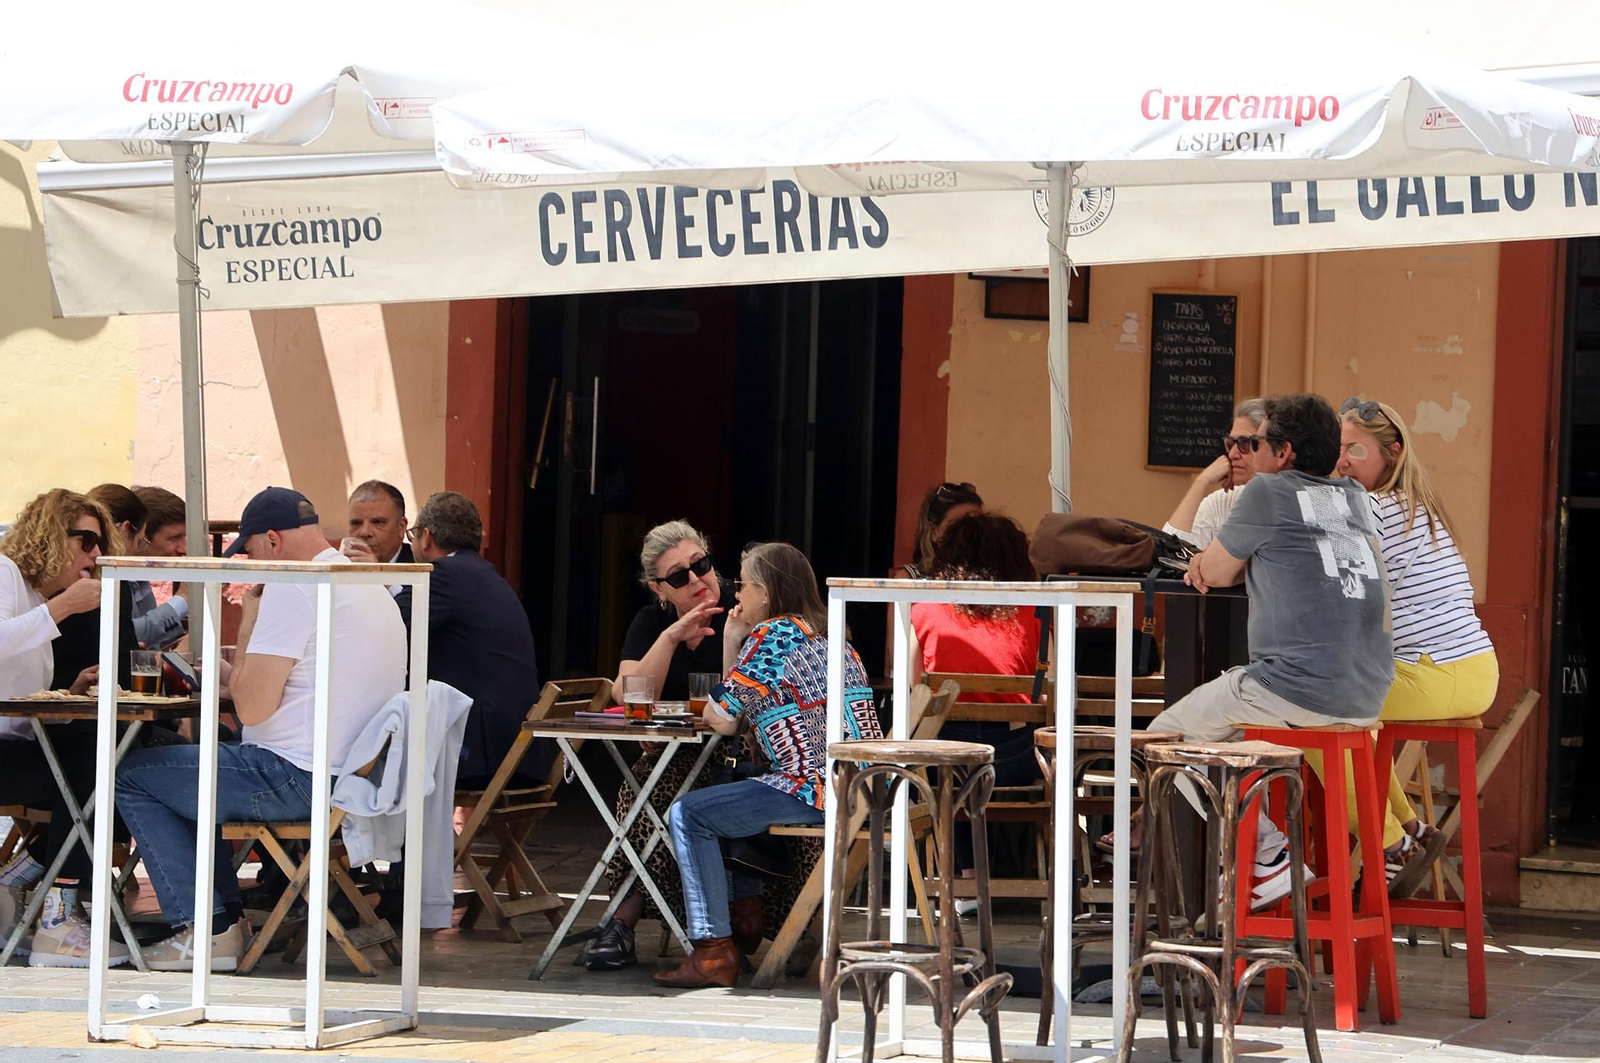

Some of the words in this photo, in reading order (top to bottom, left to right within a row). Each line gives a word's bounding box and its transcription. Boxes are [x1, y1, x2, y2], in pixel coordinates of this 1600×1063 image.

[123, 72, 294, 109] Cruzcampo
[1140, 86, 1340, 127] Cruzcampo
[147, 112, 250, 133] ESPECIAL
[1176, 131, 1291, 153] ESPECIAL
[198, 214, 382, 250] Cruzcampo
[538, 179, 889, 267] CERVECERIAS
[226, 254, 355, 284] ESPECIAL
[1174, 302, 1204, 316] TAPAS
